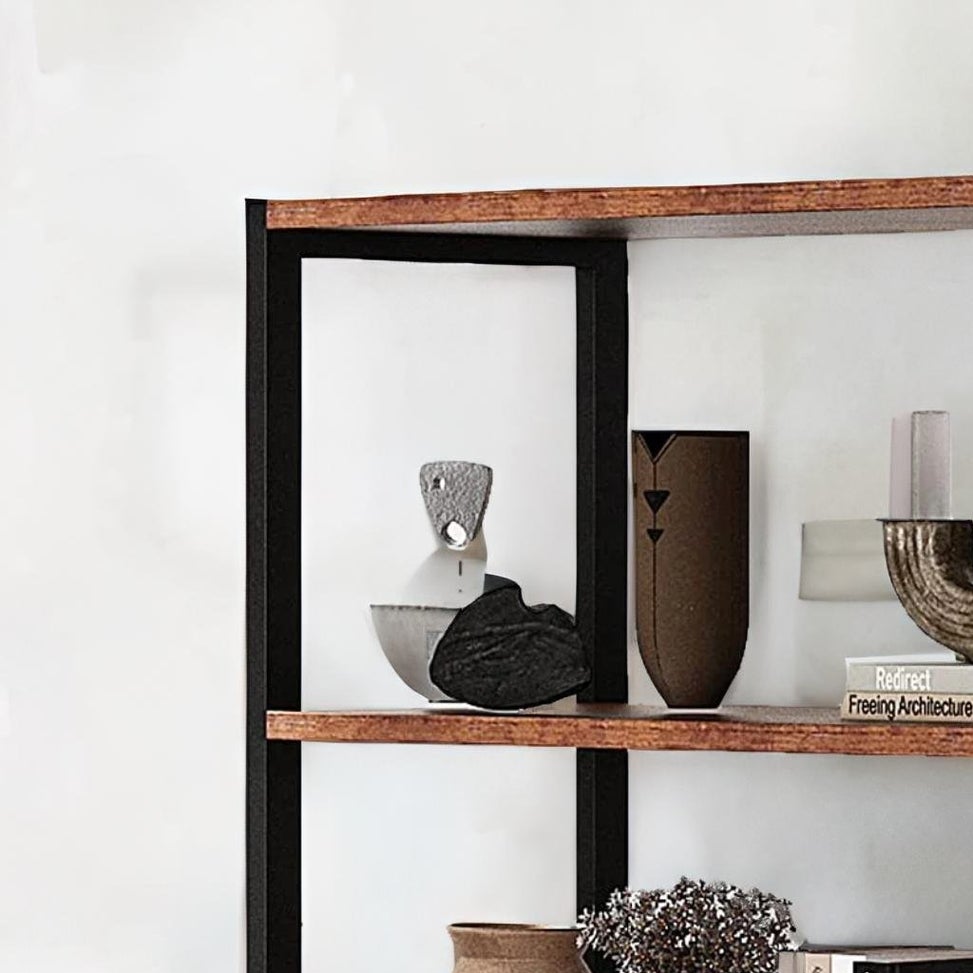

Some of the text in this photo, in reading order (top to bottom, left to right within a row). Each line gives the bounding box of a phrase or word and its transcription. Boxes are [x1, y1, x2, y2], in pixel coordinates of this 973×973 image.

[875, 665, 932, 691] Redirect
[848, 693, 973, 722] Freeing Architecture
